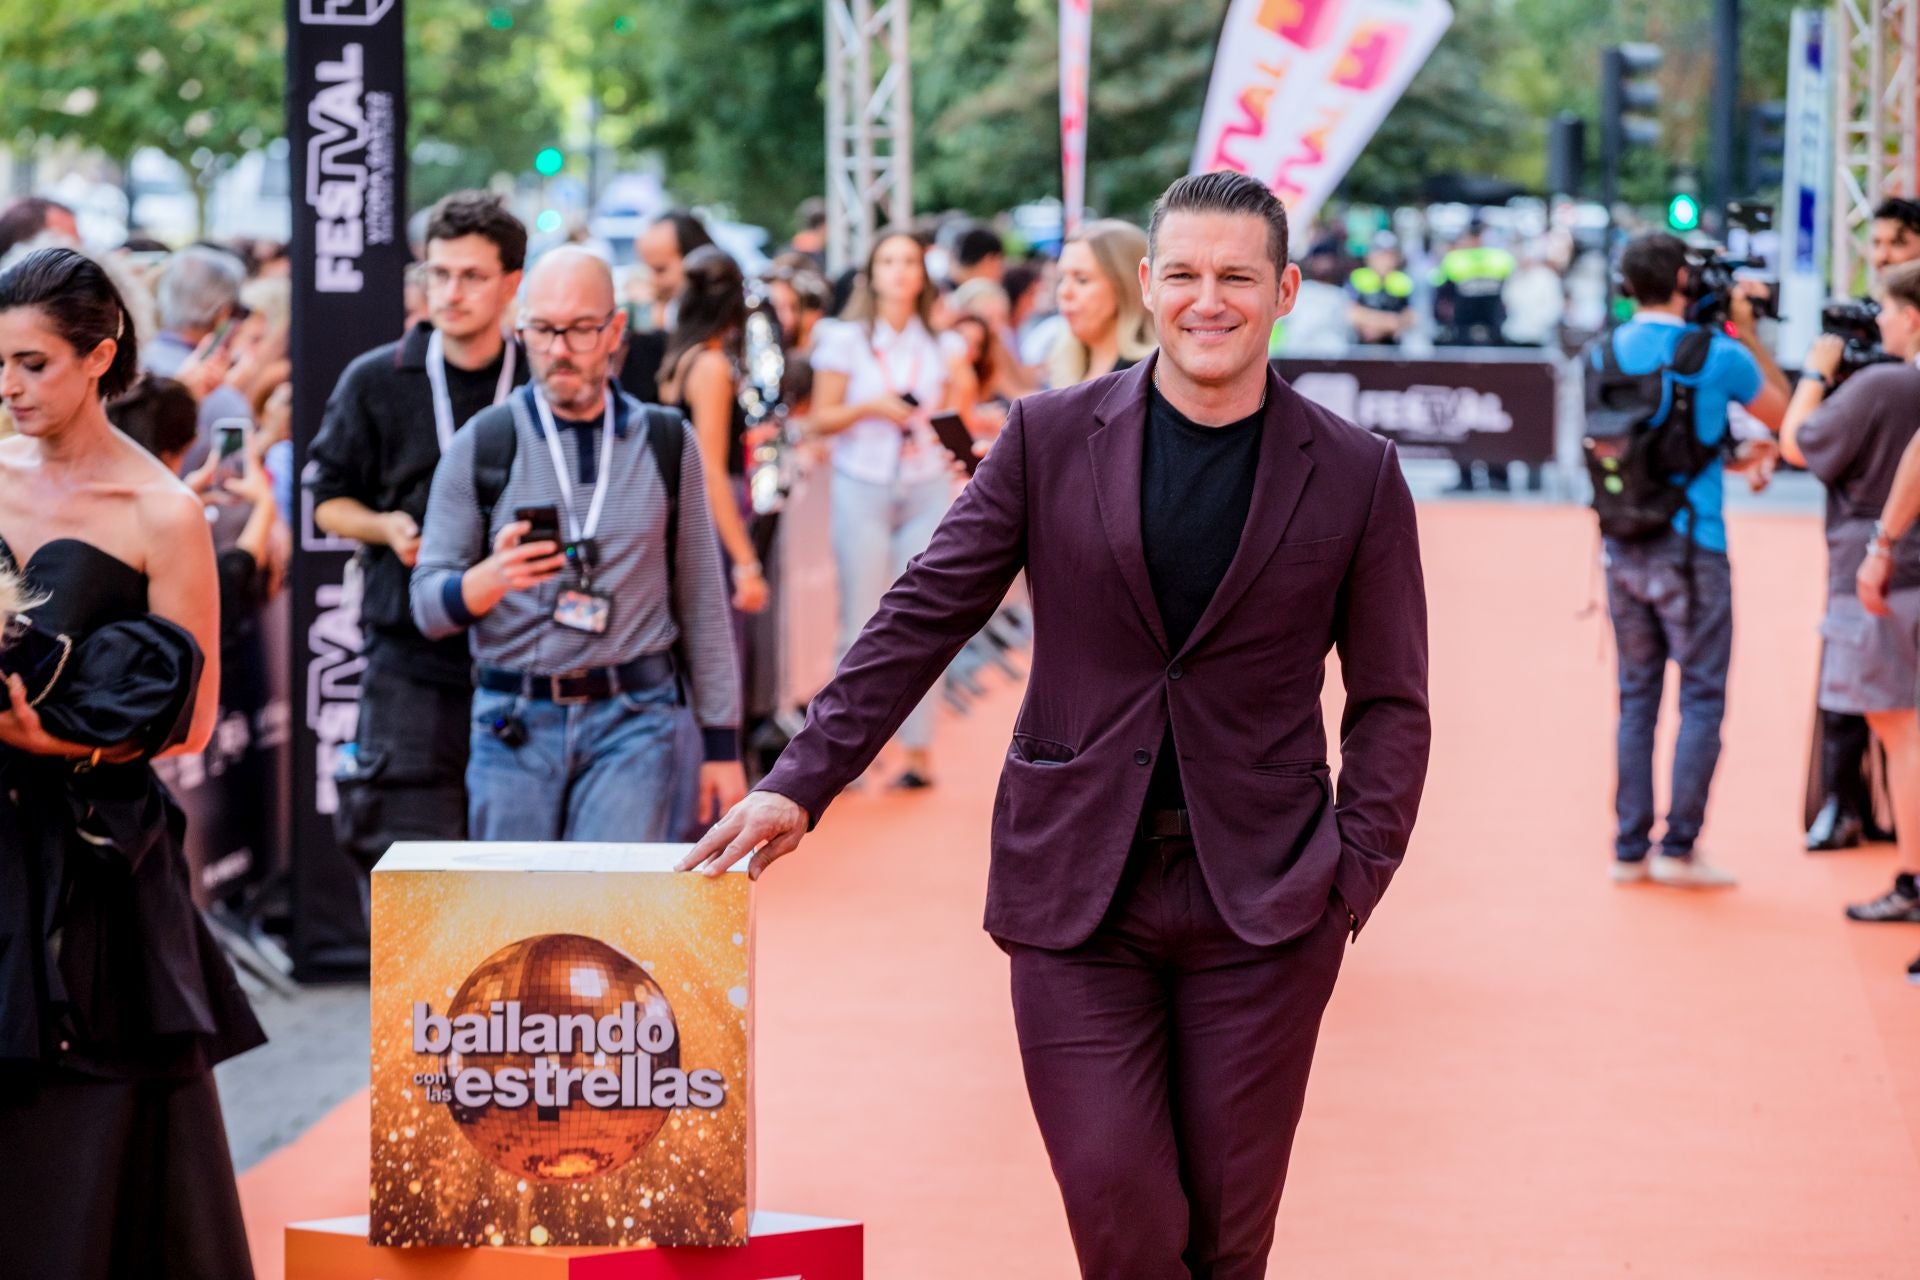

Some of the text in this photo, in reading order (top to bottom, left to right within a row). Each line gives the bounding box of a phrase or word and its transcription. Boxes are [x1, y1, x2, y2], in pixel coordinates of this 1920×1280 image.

[412, 1001, 675, 1054] bailando
[412, 1072, 447, 1085] con
[425, 1085, 452, 1103] las
[453, 1054, 726, 1108] estrellas
